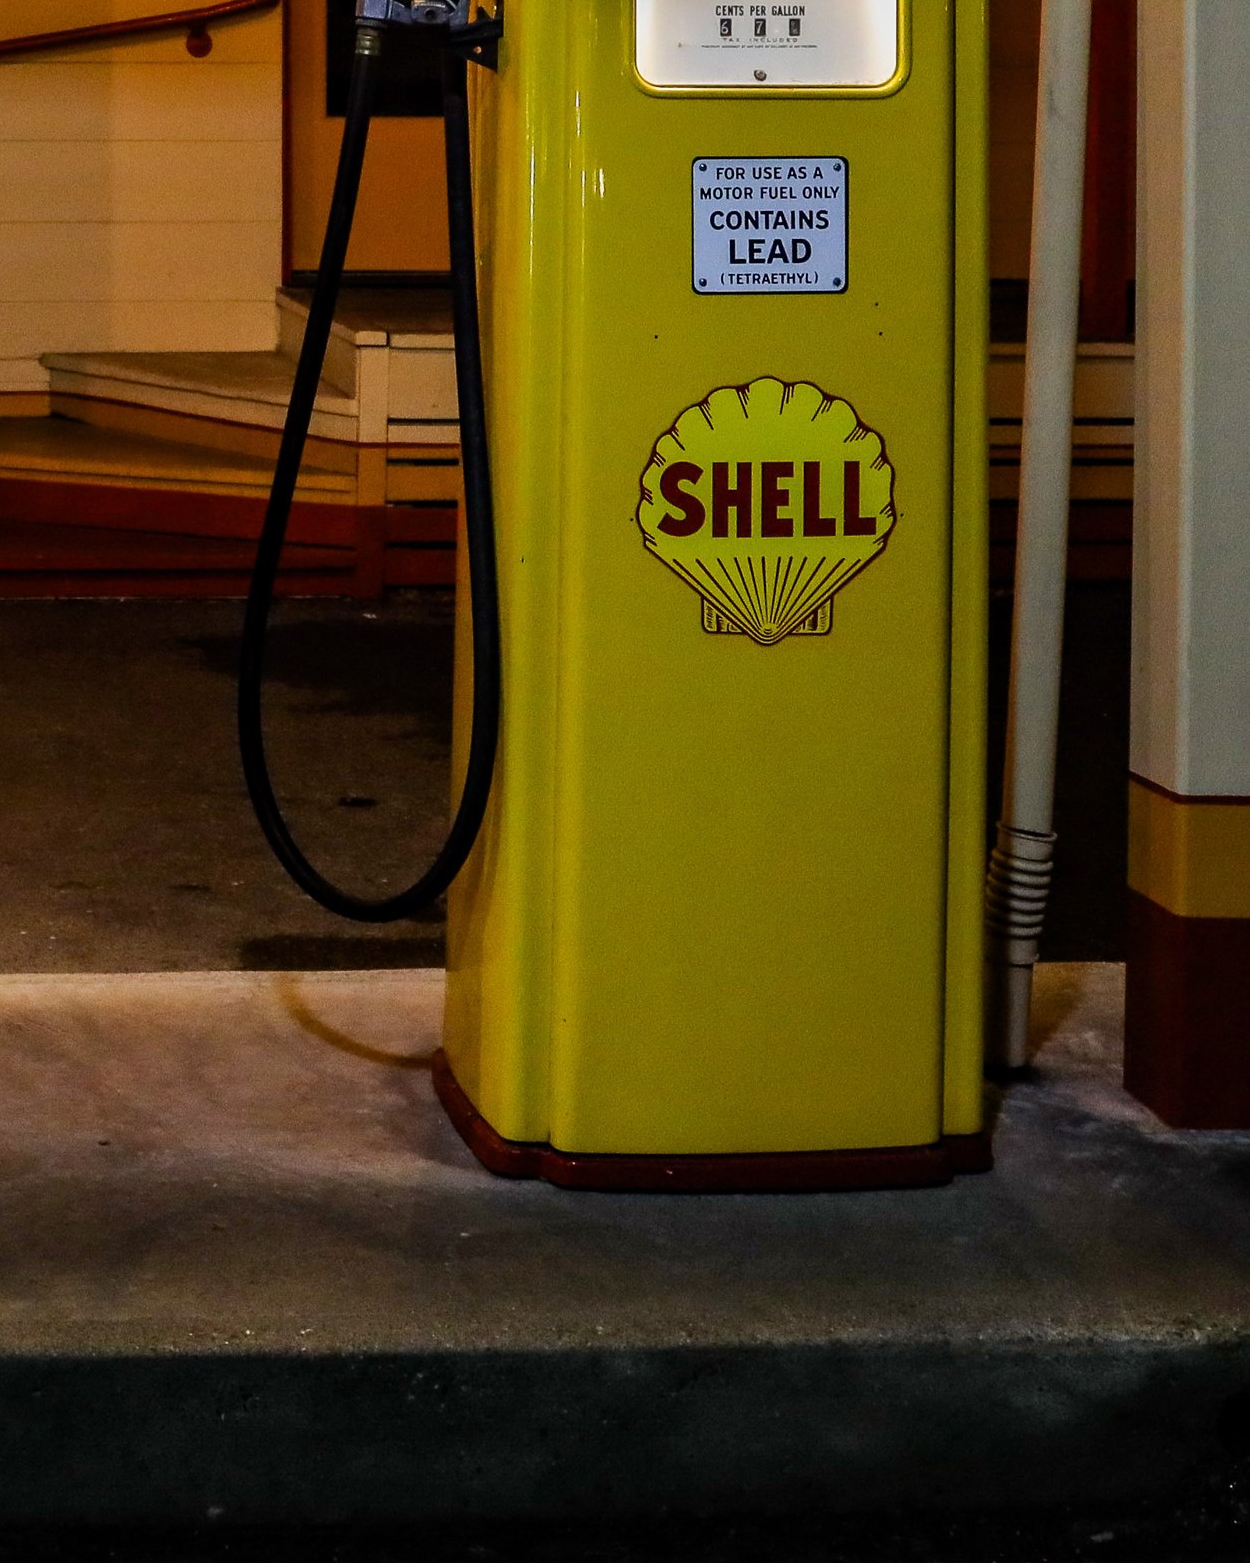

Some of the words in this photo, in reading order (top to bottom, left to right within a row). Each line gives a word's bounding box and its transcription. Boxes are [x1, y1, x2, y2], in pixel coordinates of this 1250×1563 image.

[715, 5, 744, 16] CENTS
[749, 5, 766, 16] PER
[771, 5, 806, 16] GALLON
[721, 20, 729, 35] 6
[755, 20, 763, 35] 7
[716, 167, 745, 180] FOR
[752, 167, 782, 180] USE
[787, 166, 807, 180] AS
[813, 166, 823, 179] A
[700, 187, 753, 200] MOTOR
[760, 186, 797, 199] FUEL
[802, 186, 840, 199] ONLY
[709, 210, 830, 230] CONTAINS
[728, 238, 812, 265] LEAD
[656, 460, 877, 538] SHELL
